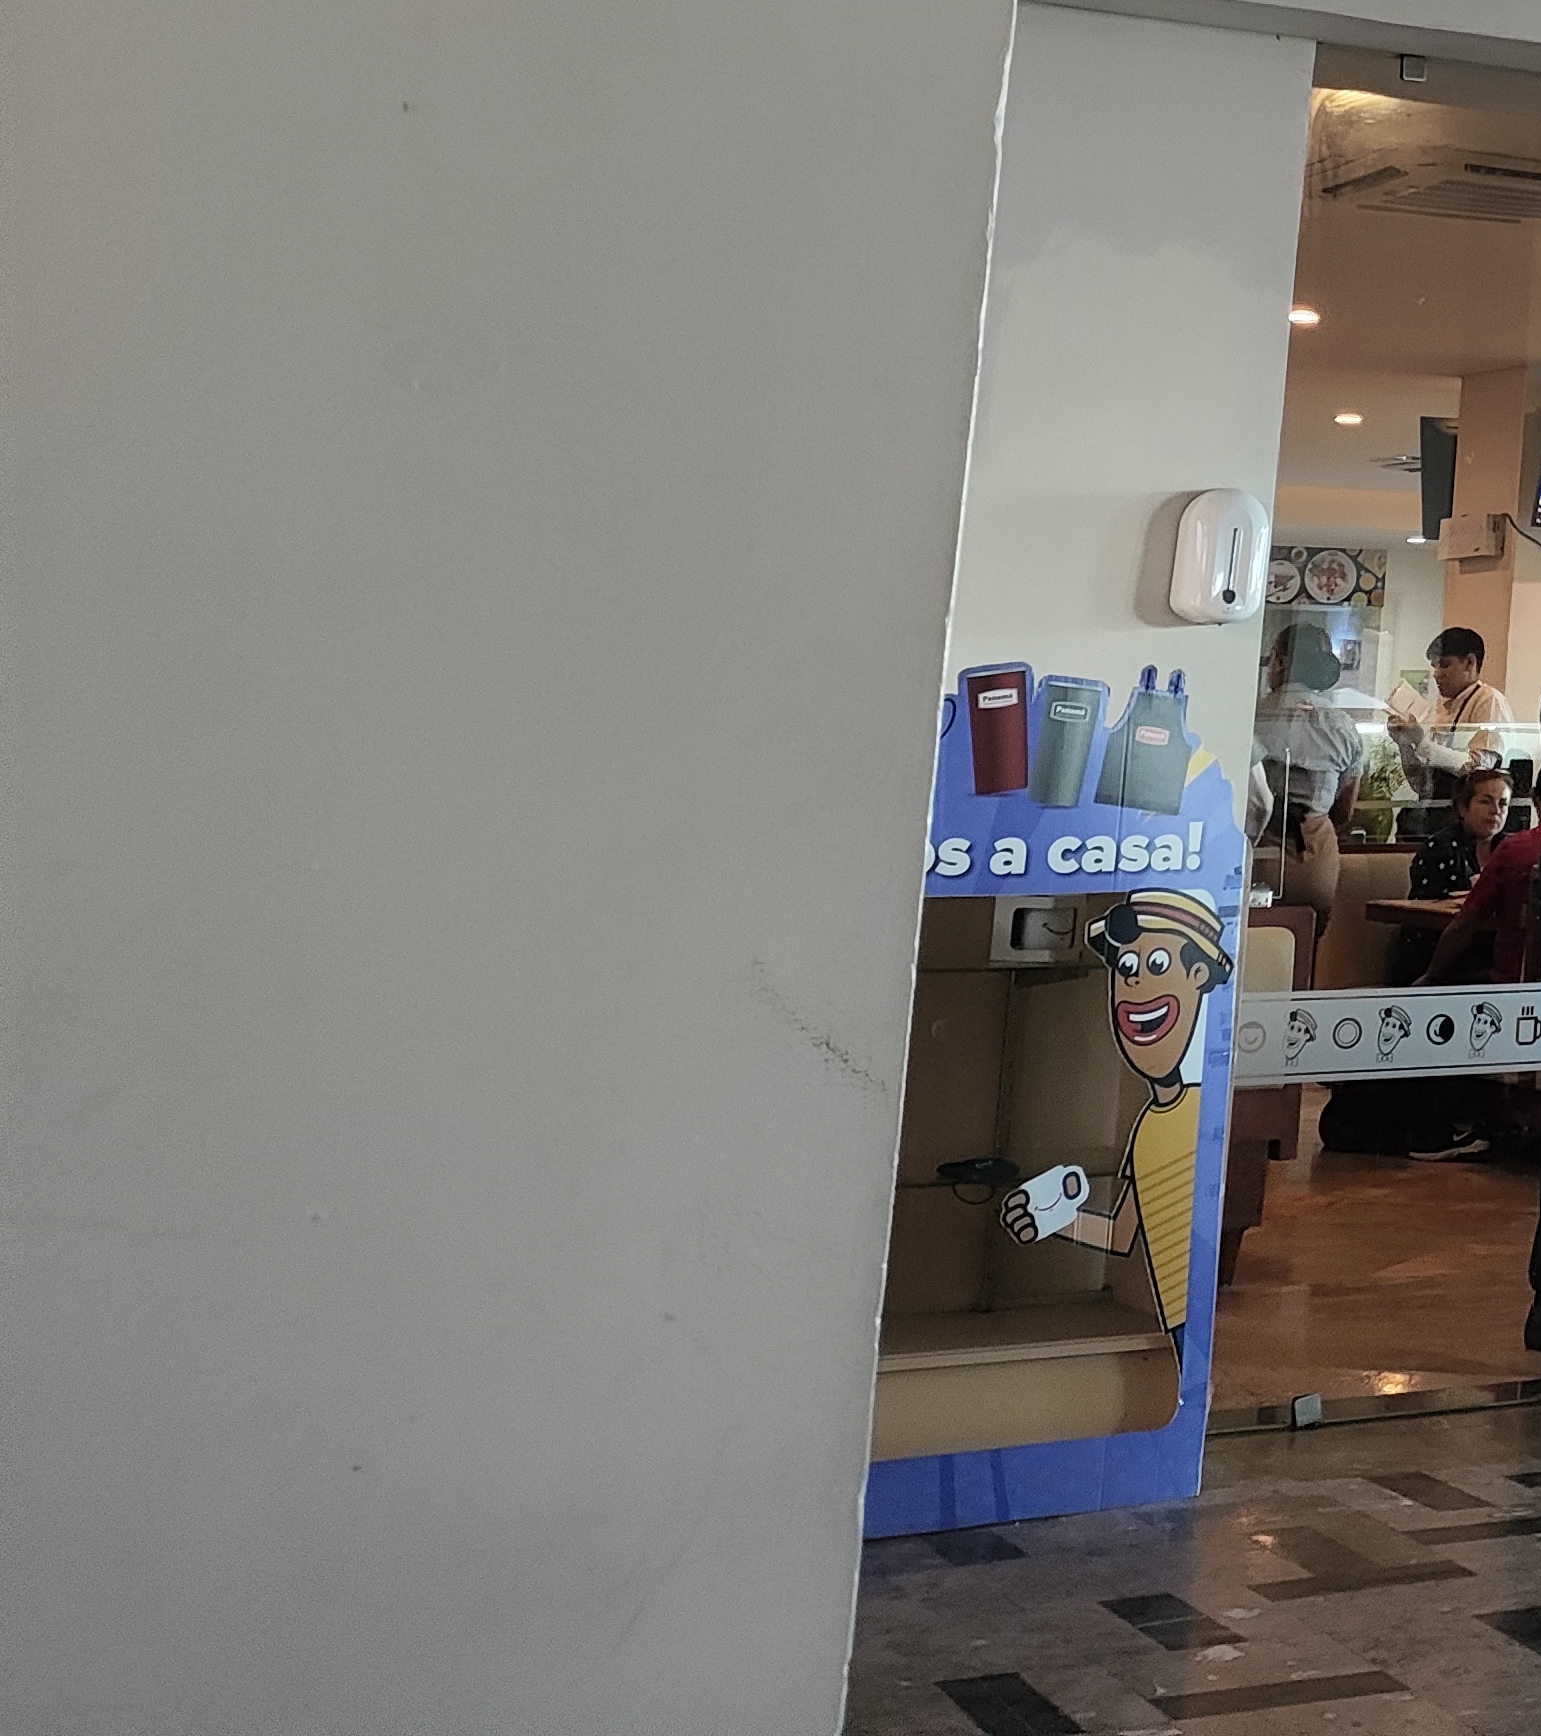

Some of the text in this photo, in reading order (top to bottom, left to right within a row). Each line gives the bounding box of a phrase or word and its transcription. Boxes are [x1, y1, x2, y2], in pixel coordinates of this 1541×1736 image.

[925, 821, 1204, 876] s a casa!
